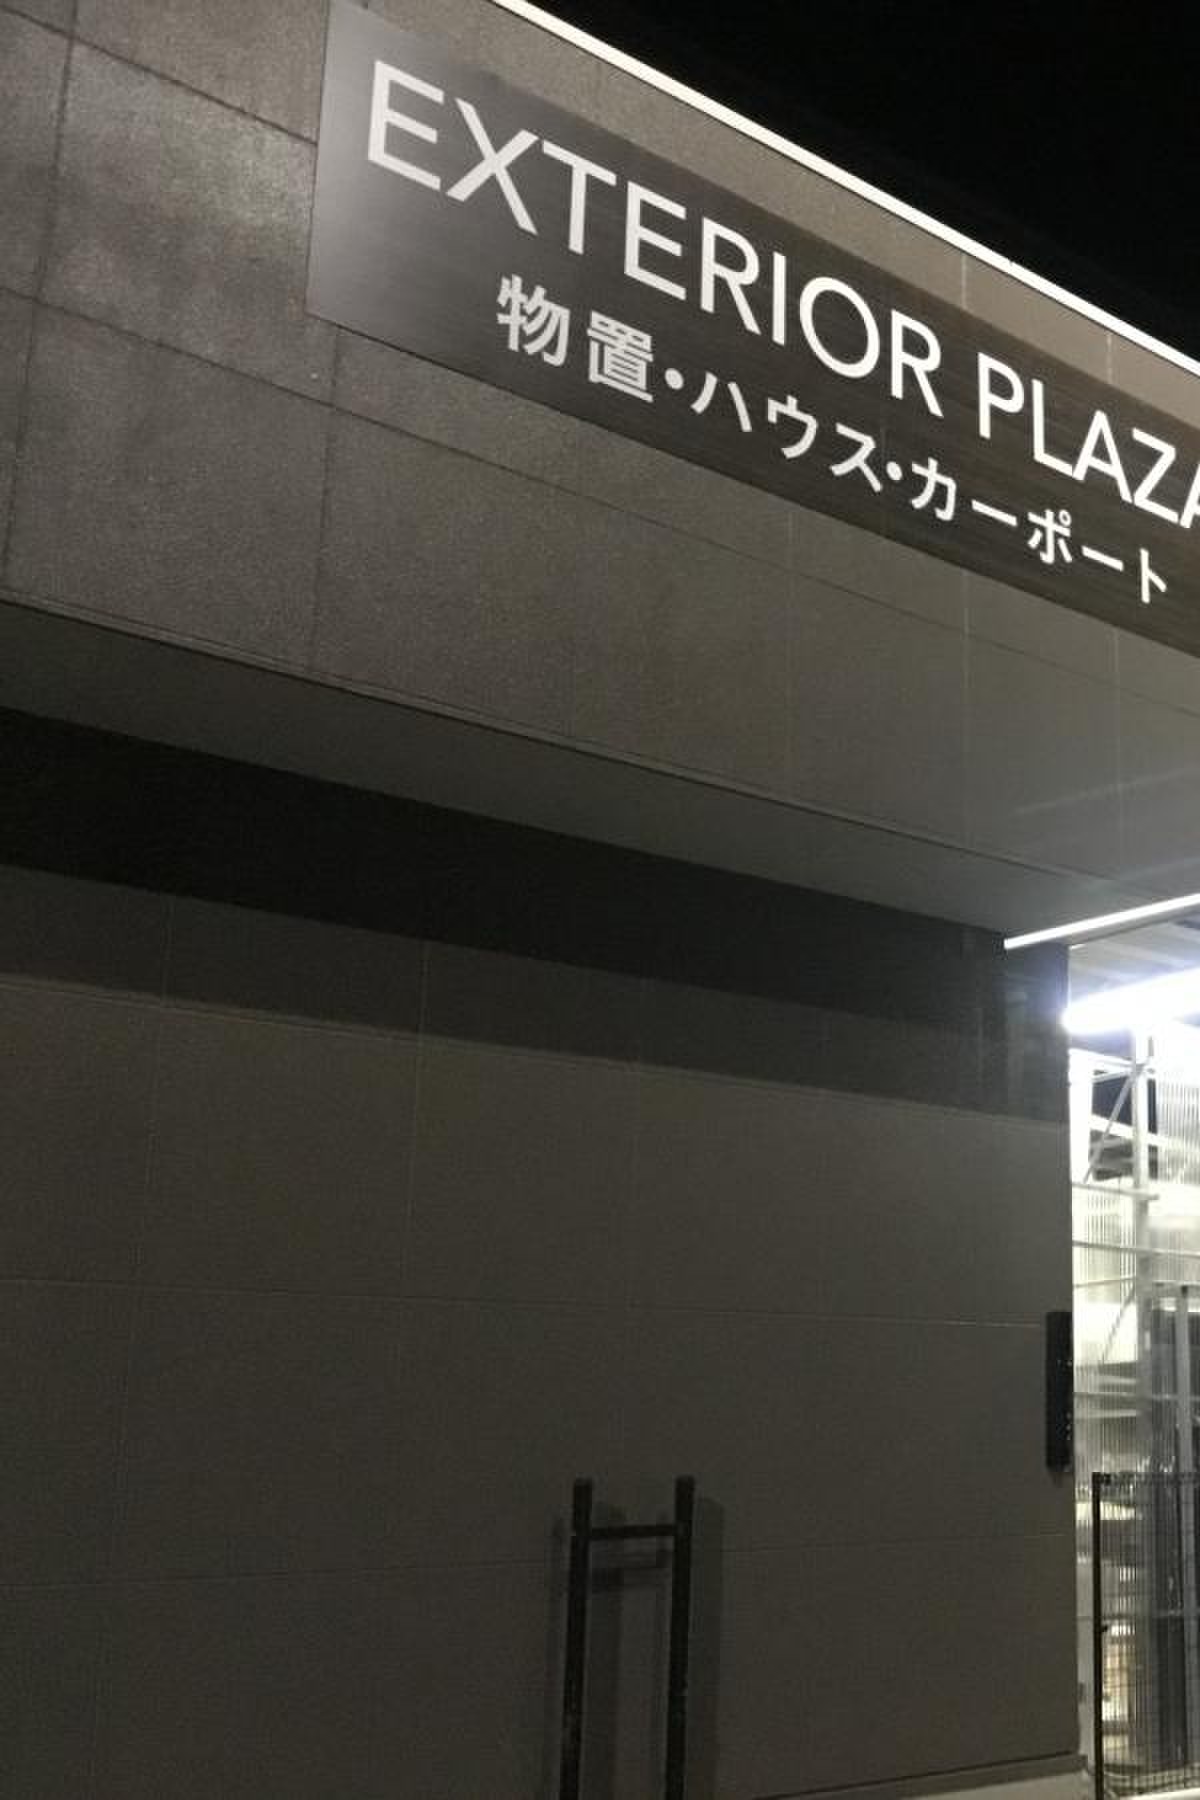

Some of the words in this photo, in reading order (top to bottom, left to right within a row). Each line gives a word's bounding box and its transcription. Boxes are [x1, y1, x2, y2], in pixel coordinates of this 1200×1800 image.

[367, 60, 943, 417] EXTERIOR
[496, 274, 1167, 603] 物置・ハウス・カーポート
